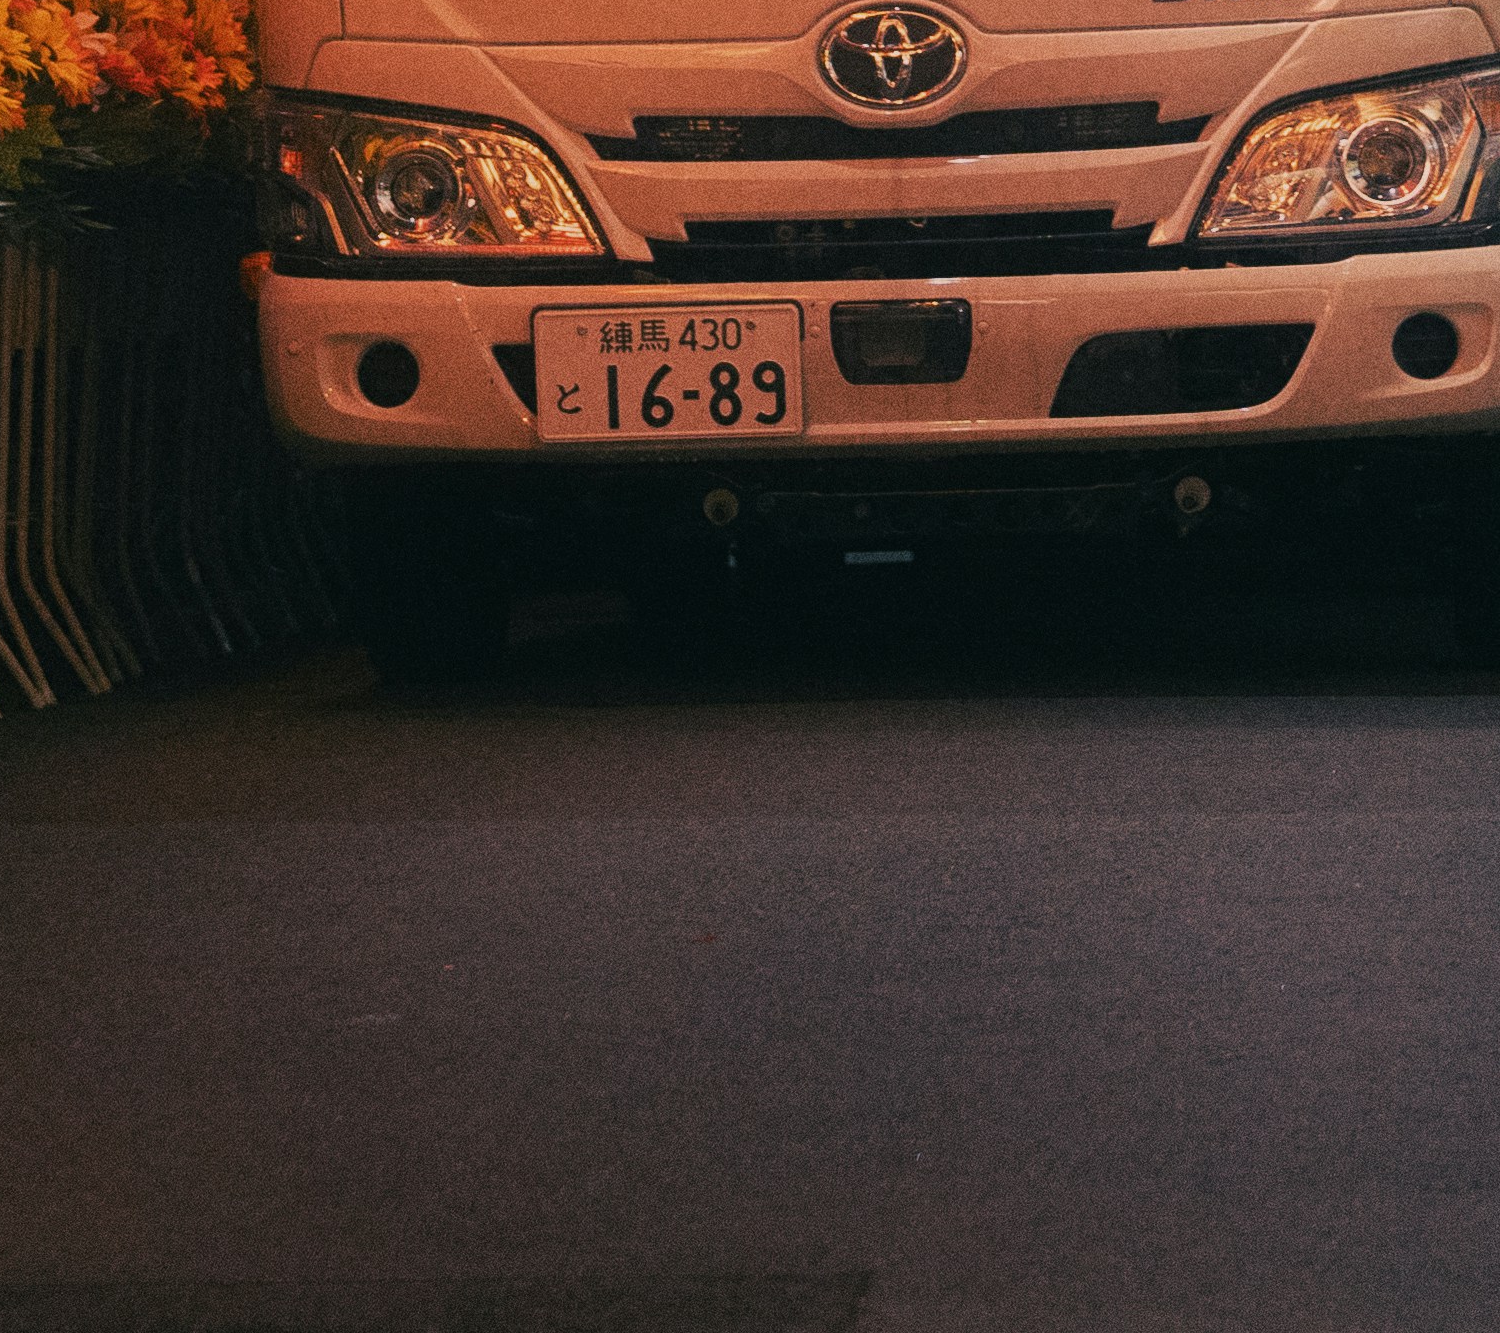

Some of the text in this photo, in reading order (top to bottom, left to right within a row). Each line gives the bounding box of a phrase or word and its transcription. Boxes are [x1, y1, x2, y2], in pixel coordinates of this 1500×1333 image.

[598, 317, 742, 353] 練馬 430
[556, 360, 788, 430] と 16-89
